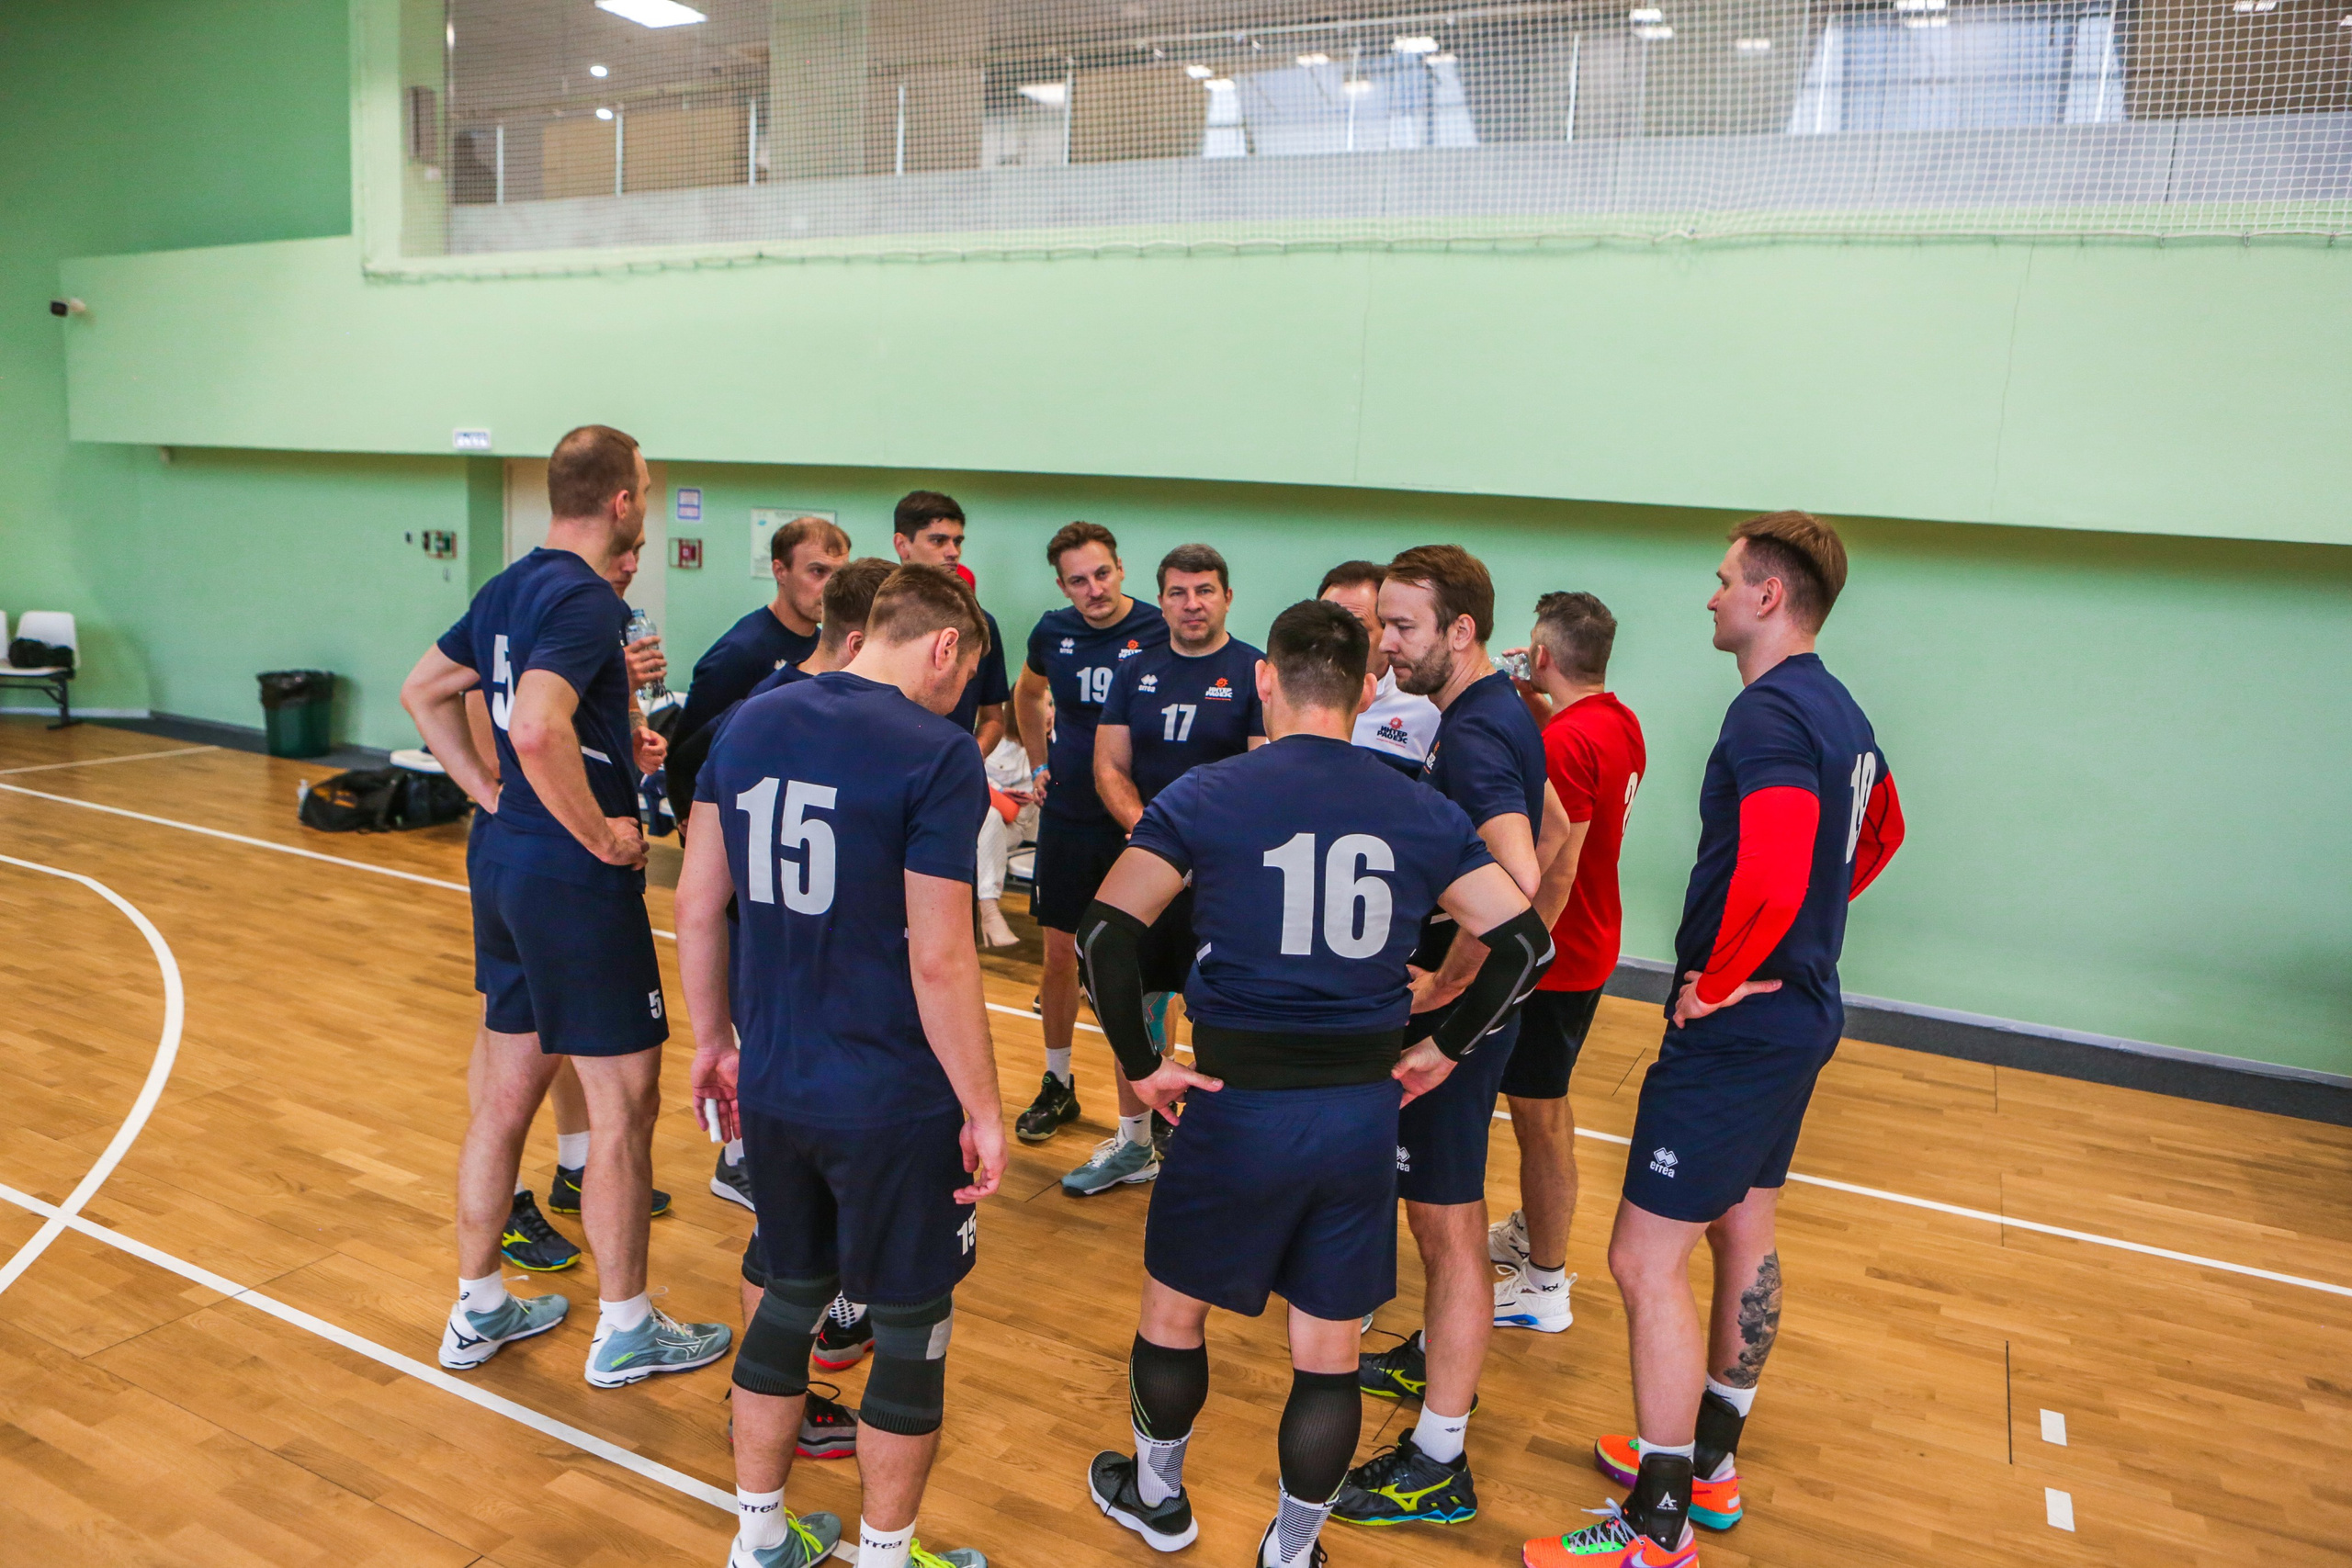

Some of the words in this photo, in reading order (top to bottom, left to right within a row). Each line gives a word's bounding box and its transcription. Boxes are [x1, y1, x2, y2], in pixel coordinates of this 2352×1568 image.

[1076, 667, 1114, 704] 19
[1161, 704, 1197, 741] 17
[1381, 725, 1408, 737] ИНТЕР
[736, 777, 837, 915] 15
[1263, 833, 1395, 959] 16
[649, 989, 662, 1019] 5
[1650, 1161, 1675, 1179] errea
[956, 1210, 976, 1256] 15
